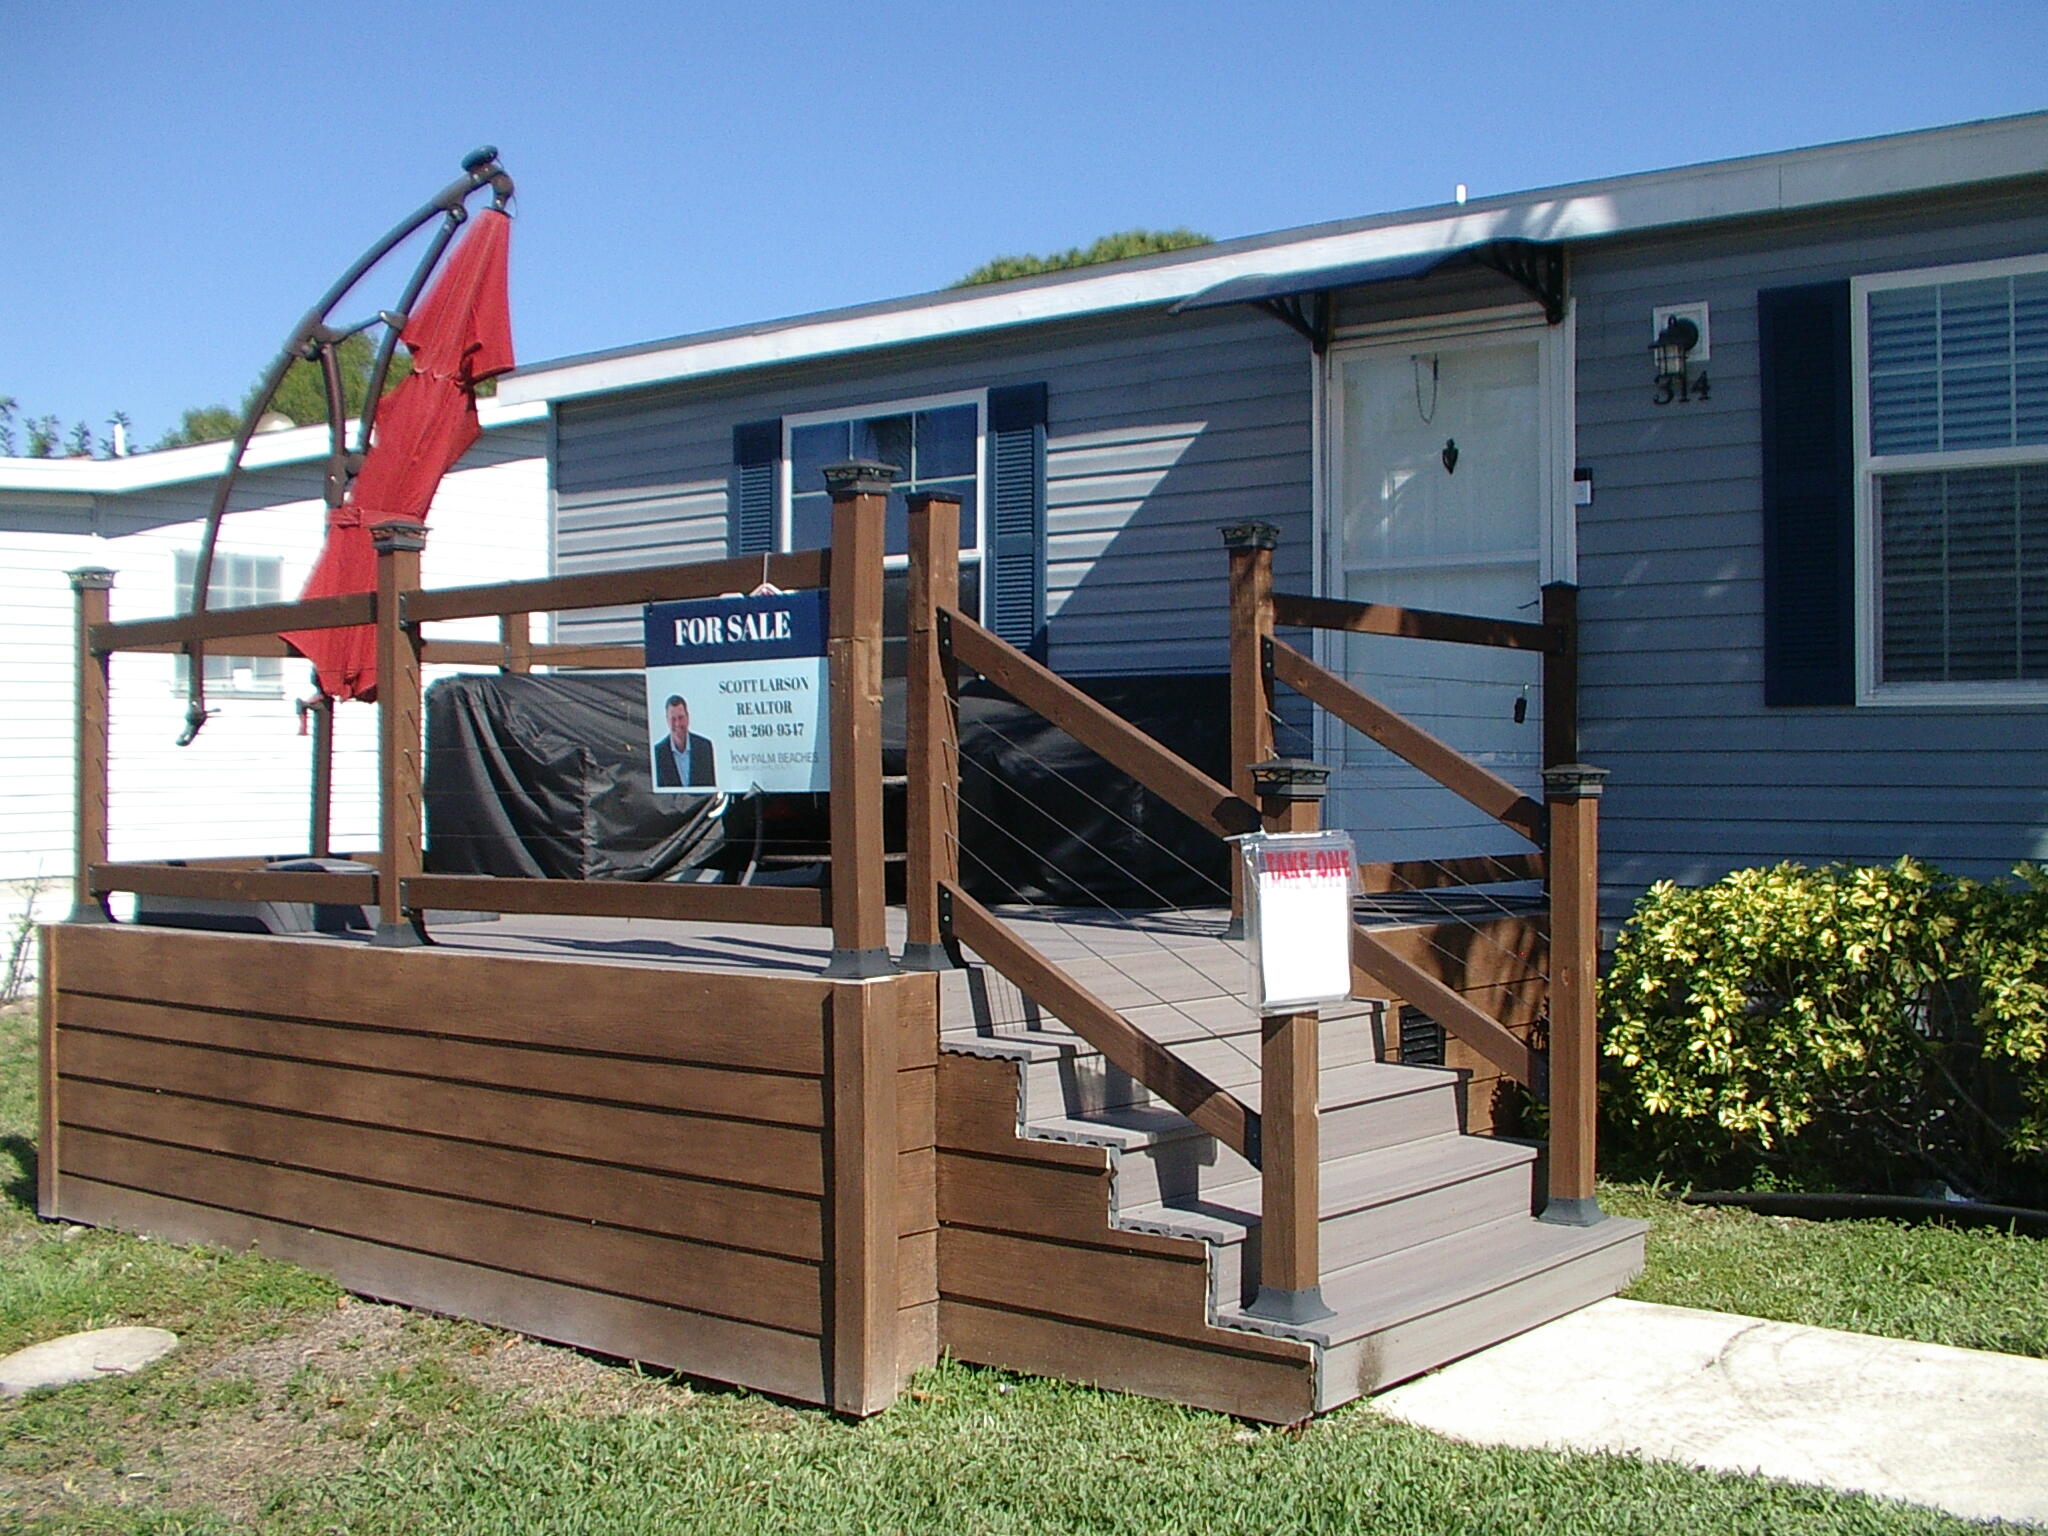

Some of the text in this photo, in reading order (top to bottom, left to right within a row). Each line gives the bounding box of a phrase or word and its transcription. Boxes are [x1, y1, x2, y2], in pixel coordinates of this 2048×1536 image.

[1653, 371, 1711, 405] 314
[674, 611, 791, 646] FOR SALE
[718, 676, 809, 694] SCOTT LARSON
[736, 700, 793, 715] REALTOR
[751, 752, 776, 764] PALM
[778, 751, 819, 763] BEACHES
[1266, 850, 1352, 880] TAKE ONE
